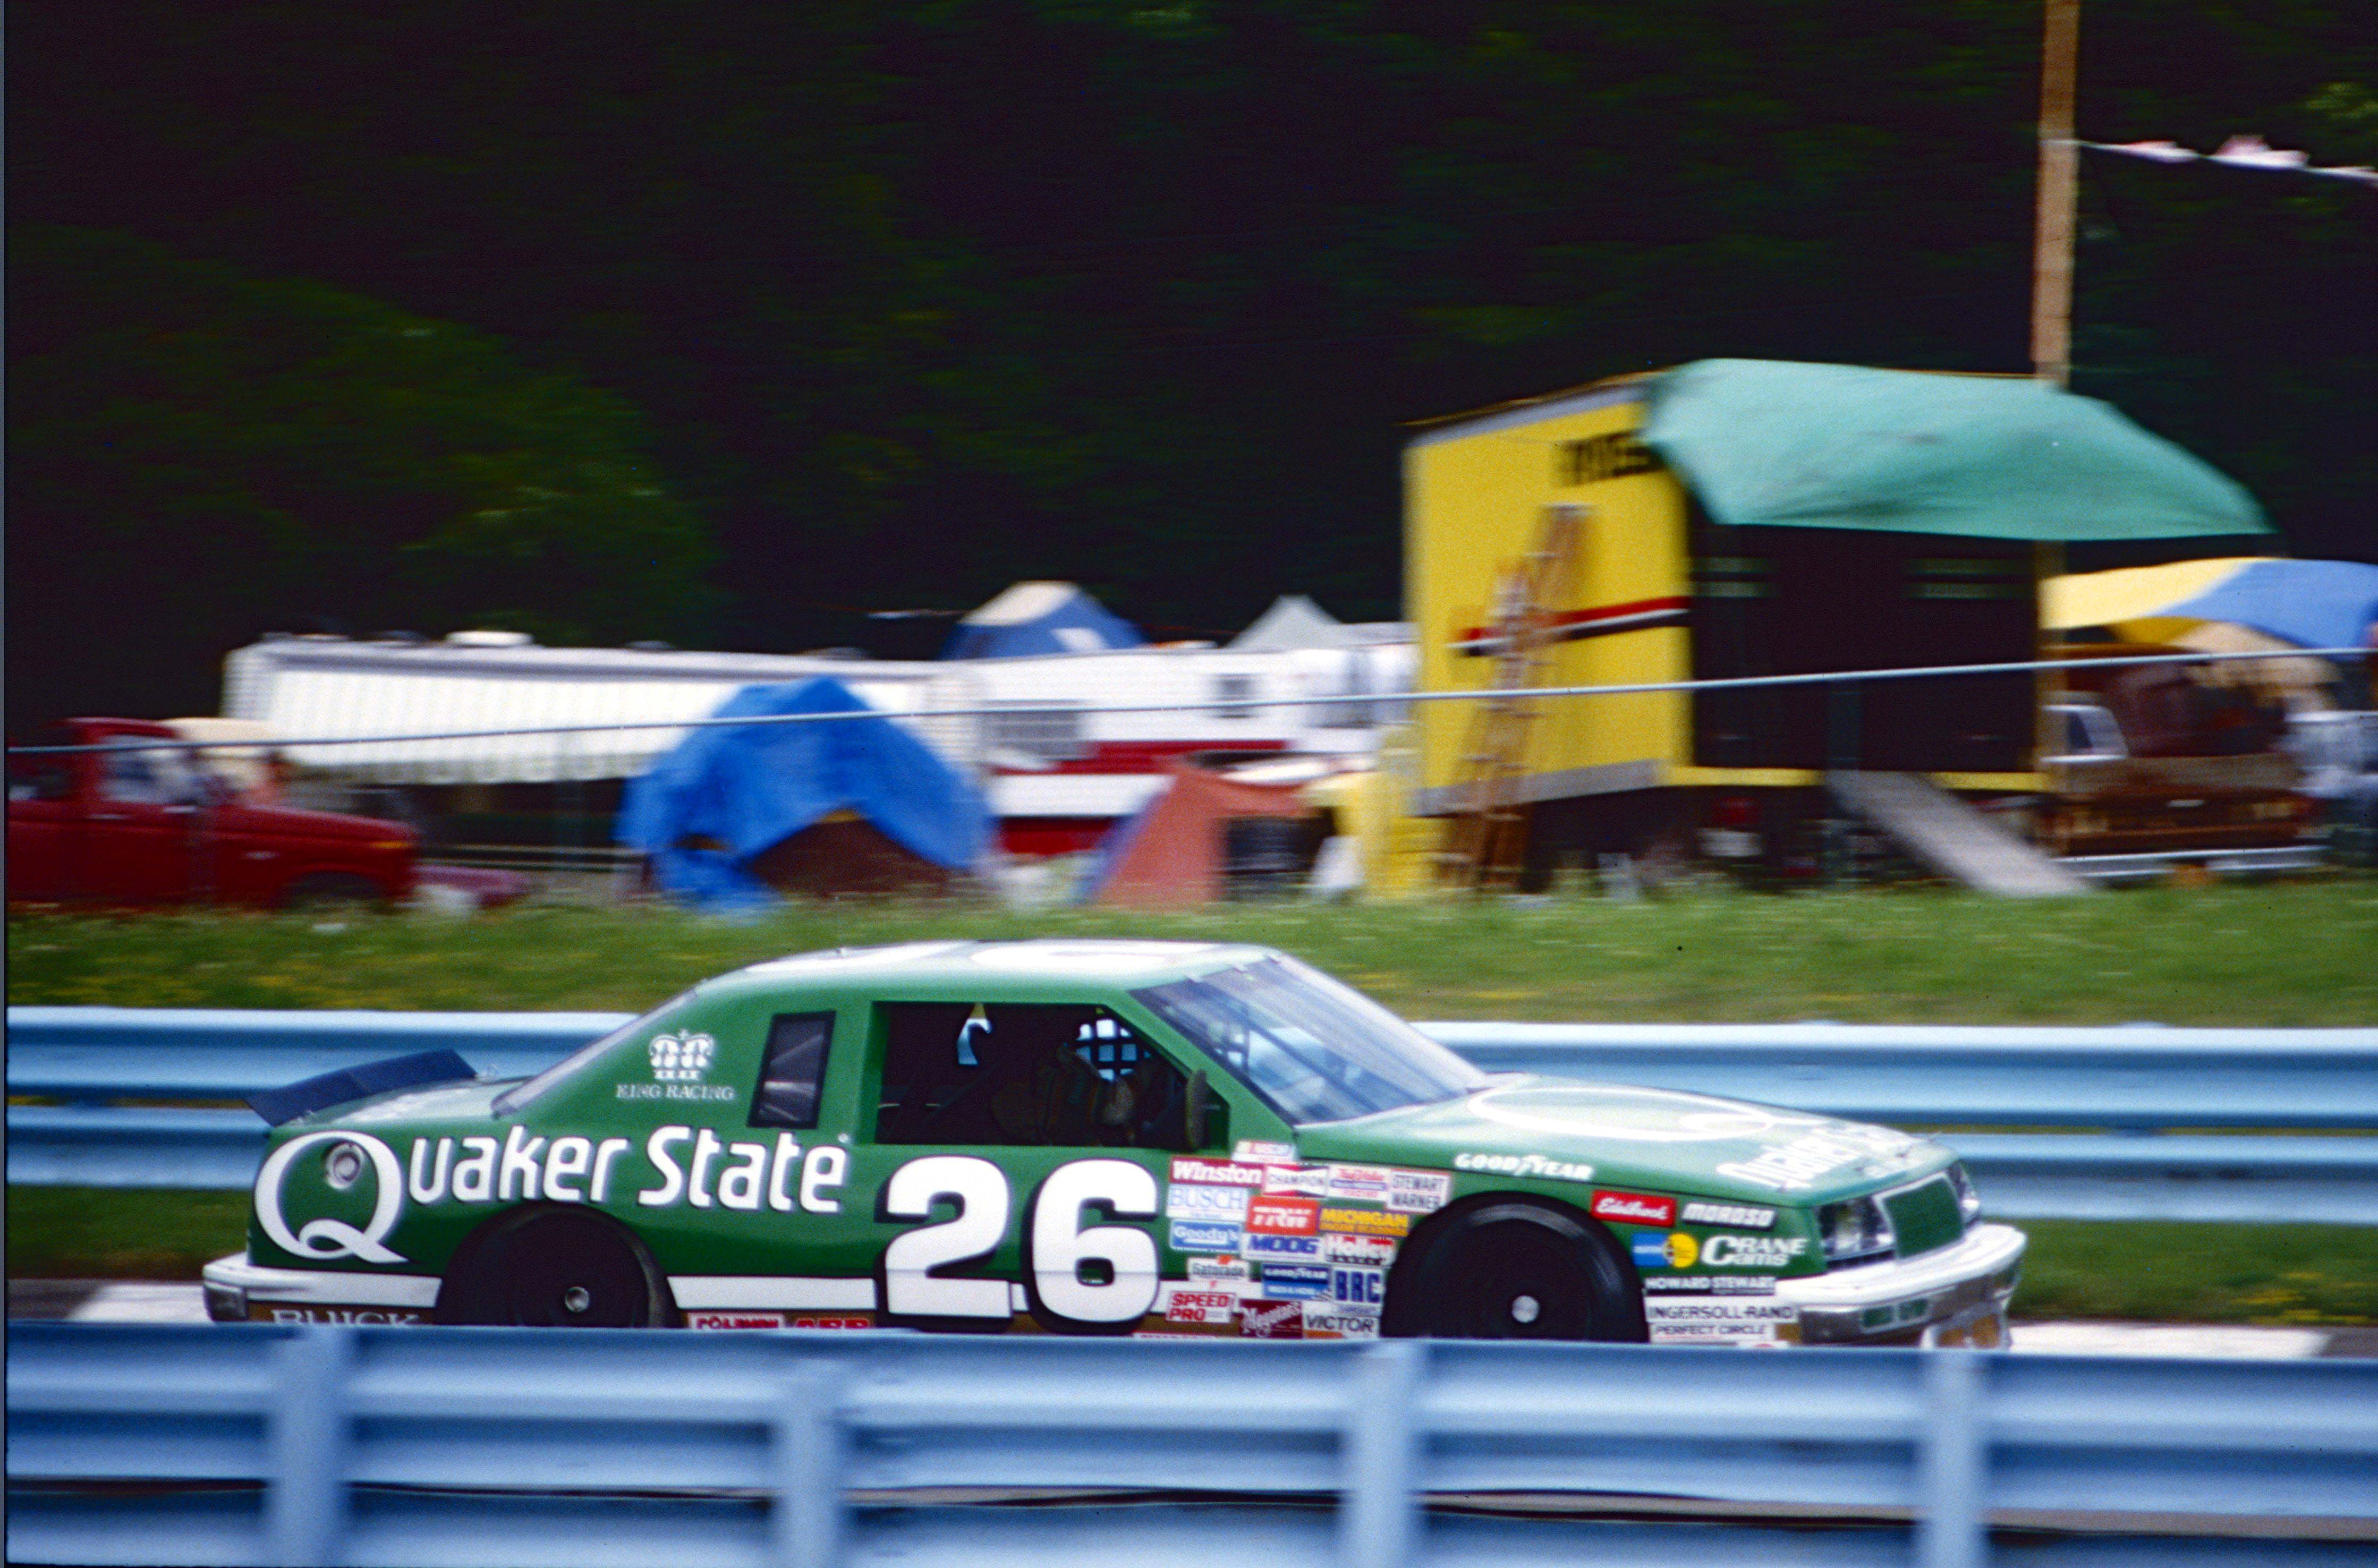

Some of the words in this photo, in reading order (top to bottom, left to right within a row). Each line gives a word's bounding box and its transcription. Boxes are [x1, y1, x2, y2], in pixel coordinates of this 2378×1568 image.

[616, 1084, 662, 1099] KING
[665, 1084, 736, 1100] RACING
[1173, 1160, 1262, 1184] Winston
[1454, 1153, 1593, 1181] GOODYEAR
[254, 1124, 629, 1264] Quaker
[638, 1125, 848, 1214] State
[1169, 1187, 1244, 1209] BUSCH
[882, 1154, 1161, 1324] 26
[1251, 1235, 1319, 1254] MOOG
[1171, 1293, 1229, 1307] SPEED
[1169, 1307, 1207, 1322] PRO
[1649, 1306, 1793, 1319] INGERSOLL-RAND
[1306, 1315, 1374, 1332] VICTOR
[1655, 1325, 1714, 1335] PERFECT
[1718, 1325, 1766, 1335] CIRCLE
